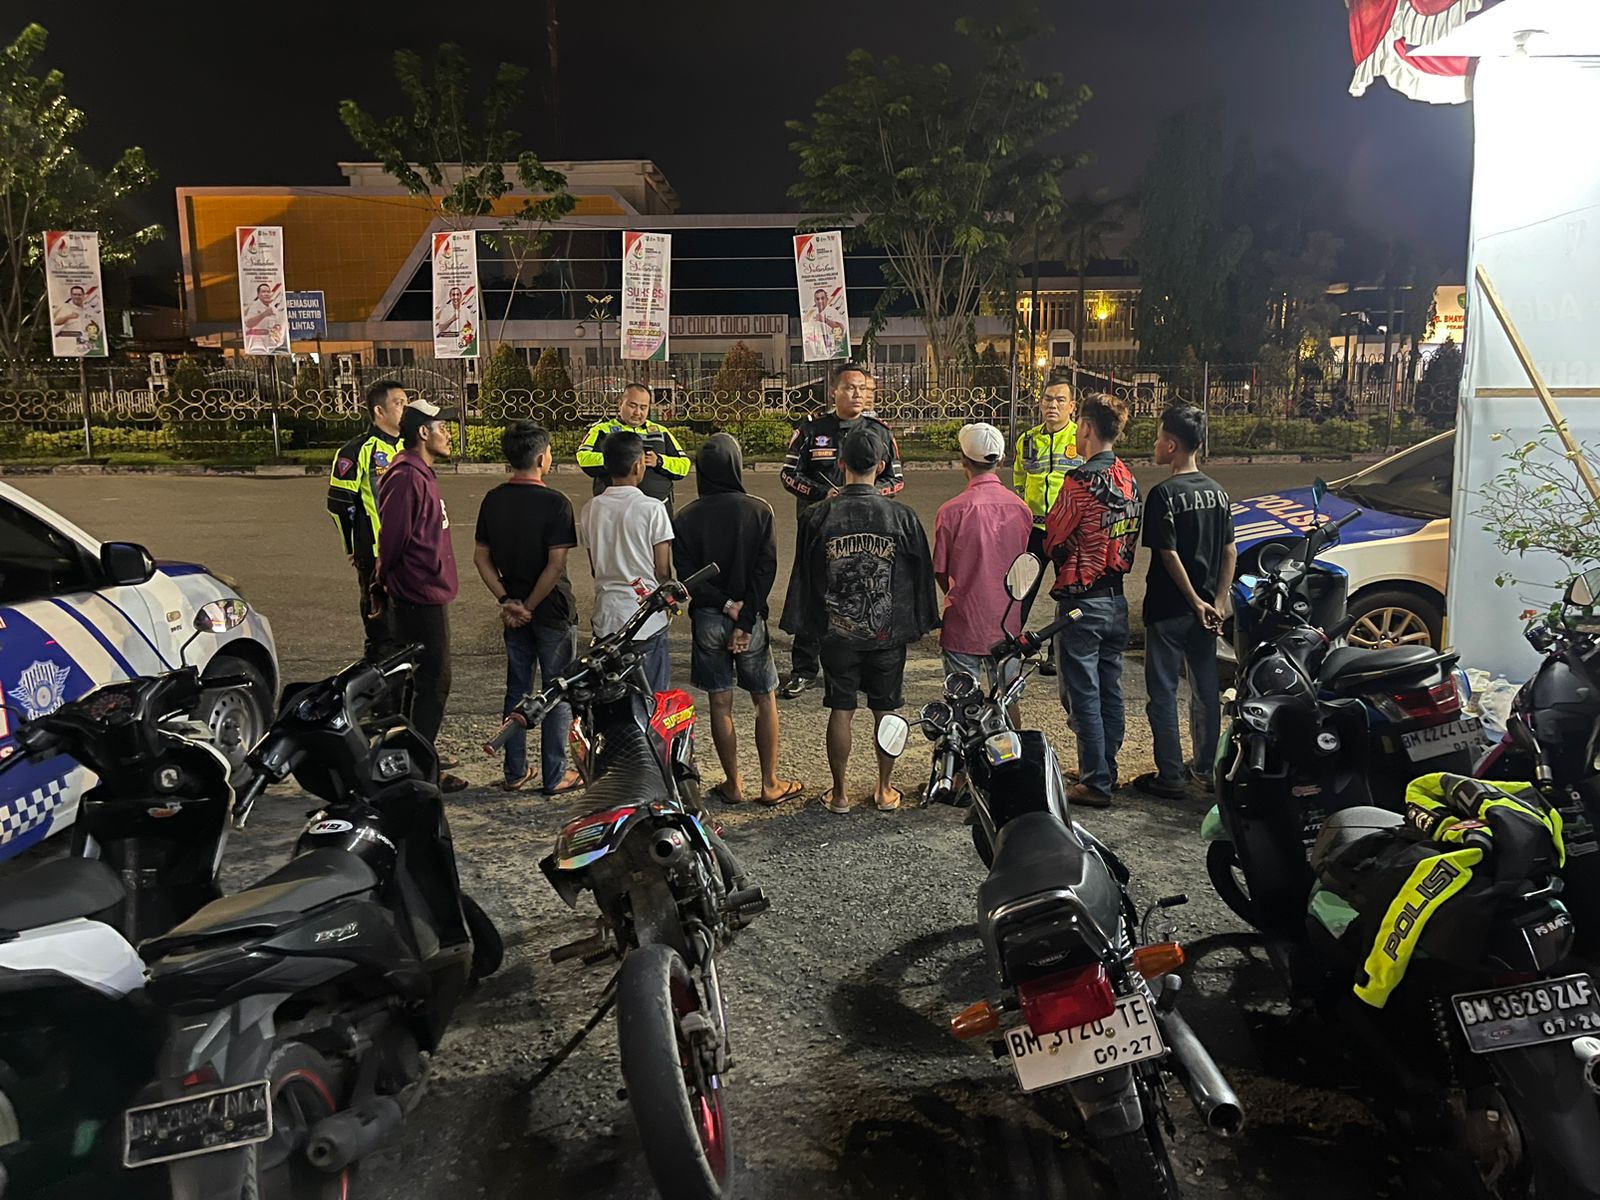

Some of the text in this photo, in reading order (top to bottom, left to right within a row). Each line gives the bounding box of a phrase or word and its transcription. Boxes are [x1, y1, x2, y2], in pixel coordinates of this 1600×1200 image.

[291, 321, 315, 330] LINTAS
[298, 310, 321, 319] TERTIB
[1383, 858, 1461, 962] POLISI
[1461, 981, 1591, 1025] BM 3629 ZAF
[1010, 1033, 1042, 1057] BM
[1116, 1000, 1147, 1028] TE
